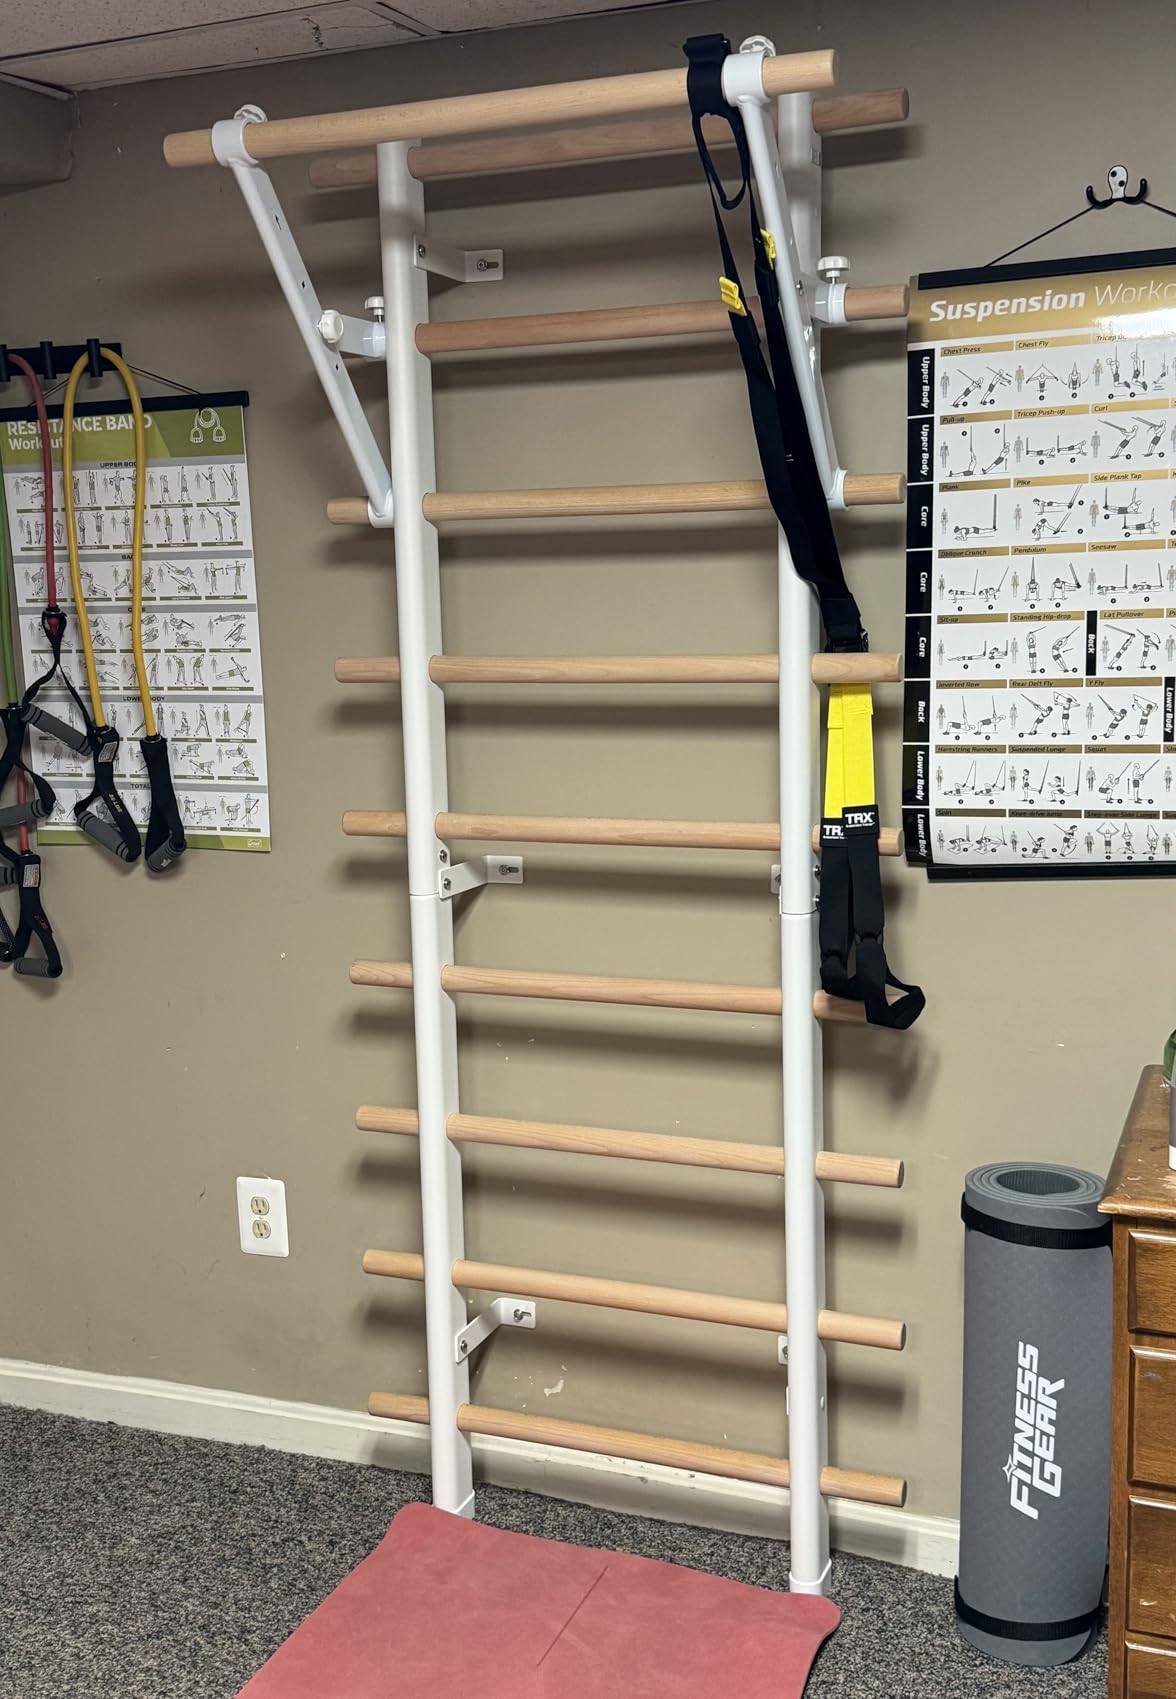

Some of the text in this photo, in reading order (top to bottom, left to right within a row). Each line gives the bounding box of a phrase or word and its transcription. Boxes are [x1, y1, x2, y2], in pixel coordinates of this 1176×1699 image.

[929, 289, 1086, 322] Suspension
[921, 356, 930, 408] Upper Body
[7, 416, 103, 436] RESITNCE
[942, 416, 965, 424] Pull-up
[8, 436, 64, 450] Workut
[920, 424, 930, 476] Upper Body
[920, 506, 928, 527] Core
[920, 572, 928, 592] Core
[918, 636, 927, 658] Core
[1088, 634, 1096, 654] Back
[1044, 680, 1054, 688] Fly
[918, 700, 926, 723] Back
[1164, 687, 1174, 734] Lower Body
[916, 750, 925, 800] Lower Body
[845, 812, 873, 825] TRX
[823, 825, 844, 836] TR
[917, 814, 928, 857] Lower Body
[1010, 1340, 1039, 1520] FITNESS
[1032, 1376, 1065, 1498] GEAR
